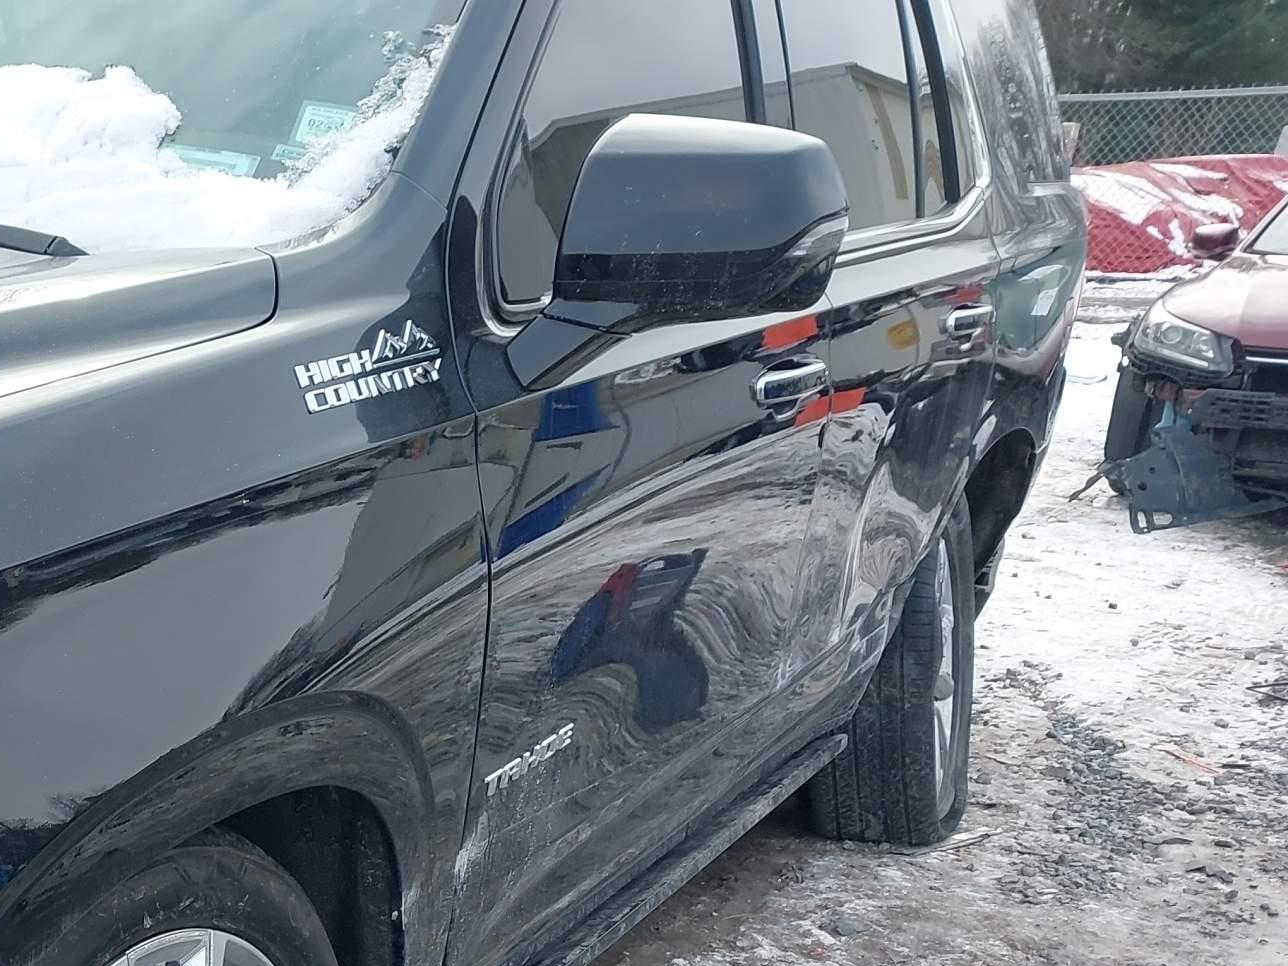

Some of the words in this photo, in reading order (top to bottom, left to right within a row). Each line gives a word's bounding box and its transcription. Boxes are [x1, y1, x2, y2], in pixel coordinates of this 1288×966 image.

[294, 349, 374, 388] HIGH
[304, 358, 442, 414] COUNTRY
[484, 723, 575, 797] TAHOE
